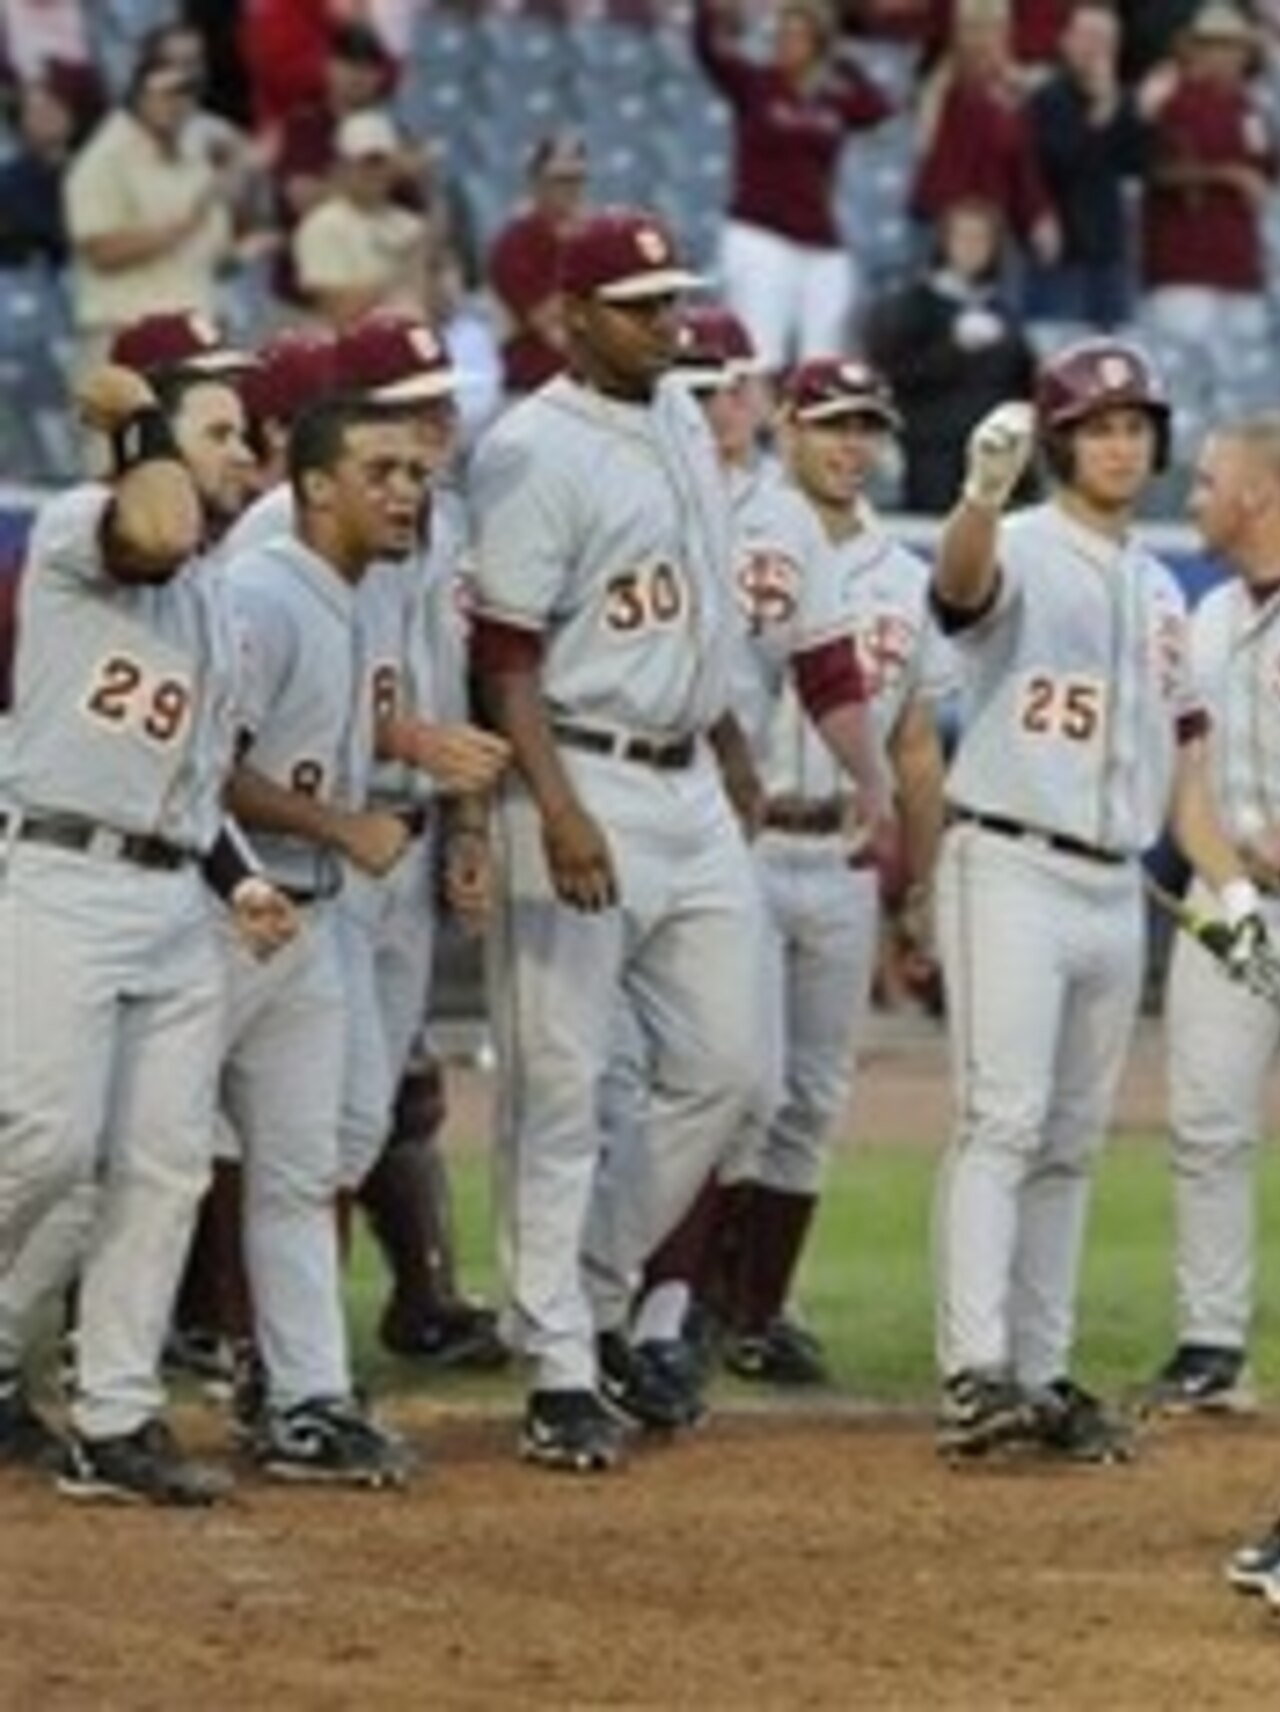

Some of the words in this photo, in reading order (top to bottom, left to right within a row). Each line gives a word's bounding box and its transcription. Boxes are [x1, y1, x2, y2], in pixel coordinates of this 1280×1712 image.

[605, 565, 683, 632] 30
[88, 658, 188, 742] 29
[1023, 678, 1100, 742] 25
